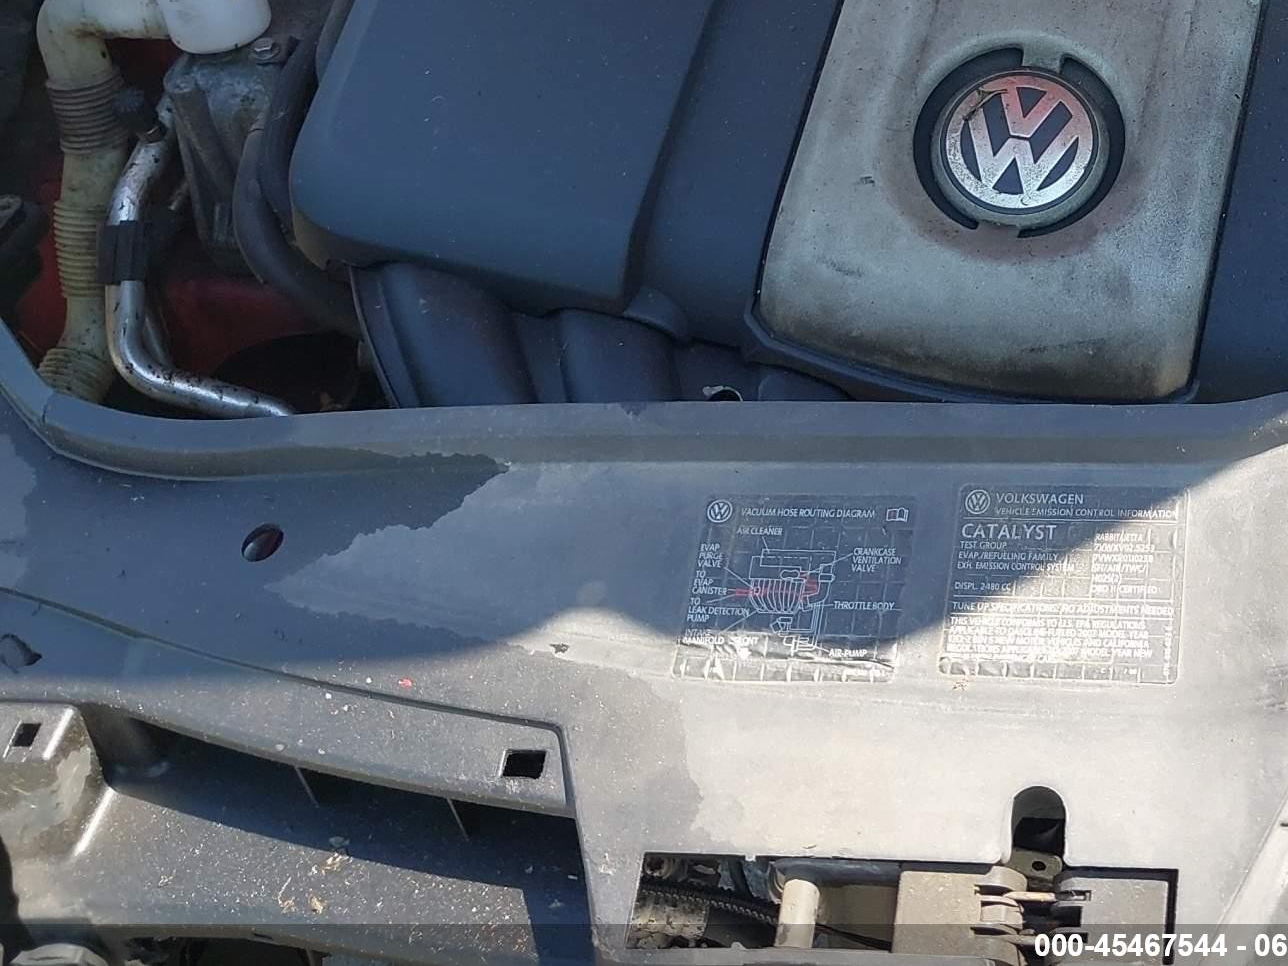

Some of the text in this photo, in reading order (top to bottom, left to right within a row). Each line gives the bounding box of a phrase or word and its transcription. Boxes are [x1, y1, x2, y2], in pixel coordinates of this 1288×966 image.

[996, 492, 1084, 505] VOLKSWAGEN
[741, 507, 875, 518] VACUUM HOSE ROUTING DIAGRAM
[996, 507, 1178, 519] VEHICLE EMISSION CONTROL INFORMATION
[750, 527, 783, 535] CLEANER
[961, 523, 1057, 540] CATALYST
[700, 543, 720, 551] EVAP
[960, 540, 1007, 549] TEST GROUP
[853, 547, 897, 556] CRANKCASE
[853, 556, 902, 564] VENTILATION
[1028, 552, 1058, 561] FAMILY
[851, 564, 876, 572] VALVE
[975, 562, 1009, 570] EMISSION
[1011, 562, 1044, 571] CONTROL
[1046, 563, 1075, 572] SYSTEM
[696, 570, 706, 578] TO
[691, 586, 727, 595] CANISTER
[954, 582, 978, 590] DISPL.
[980, 582, 1000, 591] 2480
[690, 597, 701, 605] TO
[833, 600, 895, 610] THROTTLE BODY
[688, 606, 750, 616] LEAK DETECTION
[952, 601, 976, 611] TUNE
[977, 602, 987, 611] UP
[1140, 605, 1174, 615] NEEDED
[687, 614, 710, 622] PUMP
[950, 616, 968, 625] THIS
[828, 648, 868, 658] AIR-PUMP
